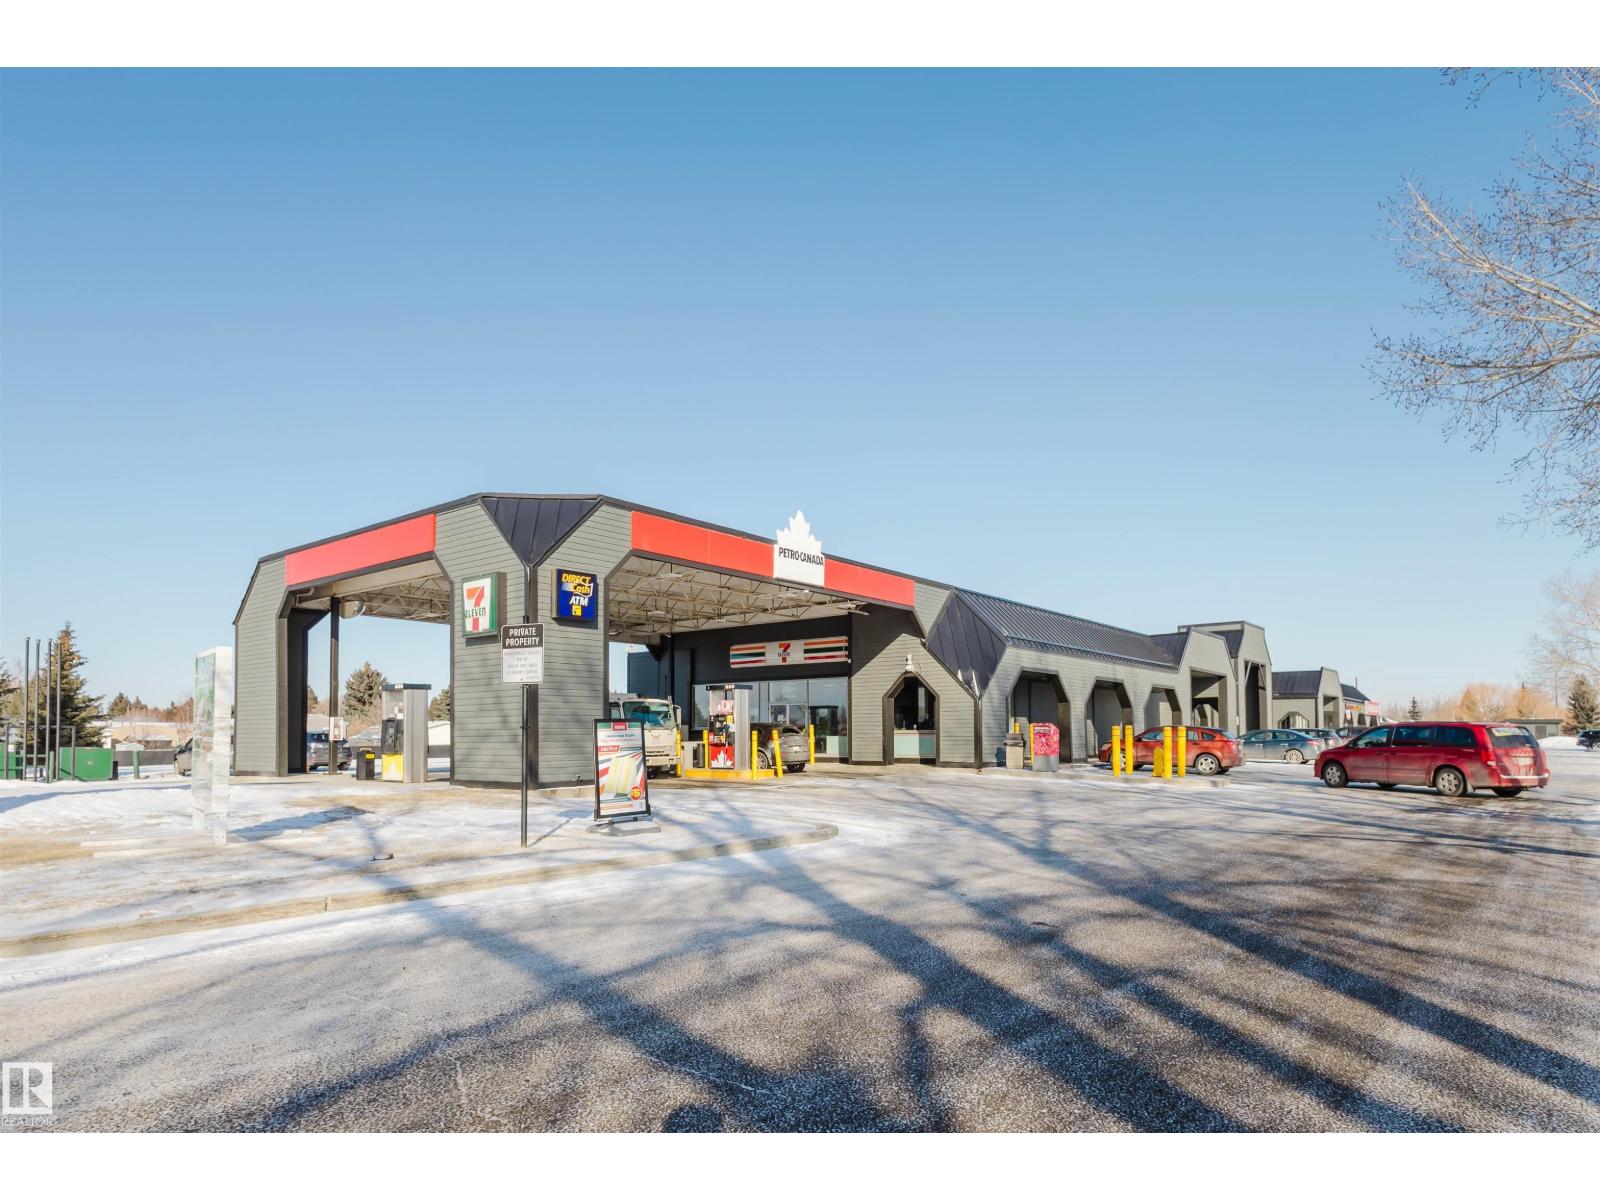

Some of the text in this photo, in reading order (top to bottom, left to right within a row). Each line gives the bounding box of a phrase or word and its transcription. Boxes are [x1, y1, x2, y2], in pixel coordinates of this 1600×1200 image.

[561, 573, 591, 585] DIRECT
[572, 582, 591, 594] Cash
[569, 595, 589, 607] ATM
[466, 585, 485, 631] 7
[509, 627, 537, 637] PRIVATE
[505, 637, 540, 647] PROPERTY
